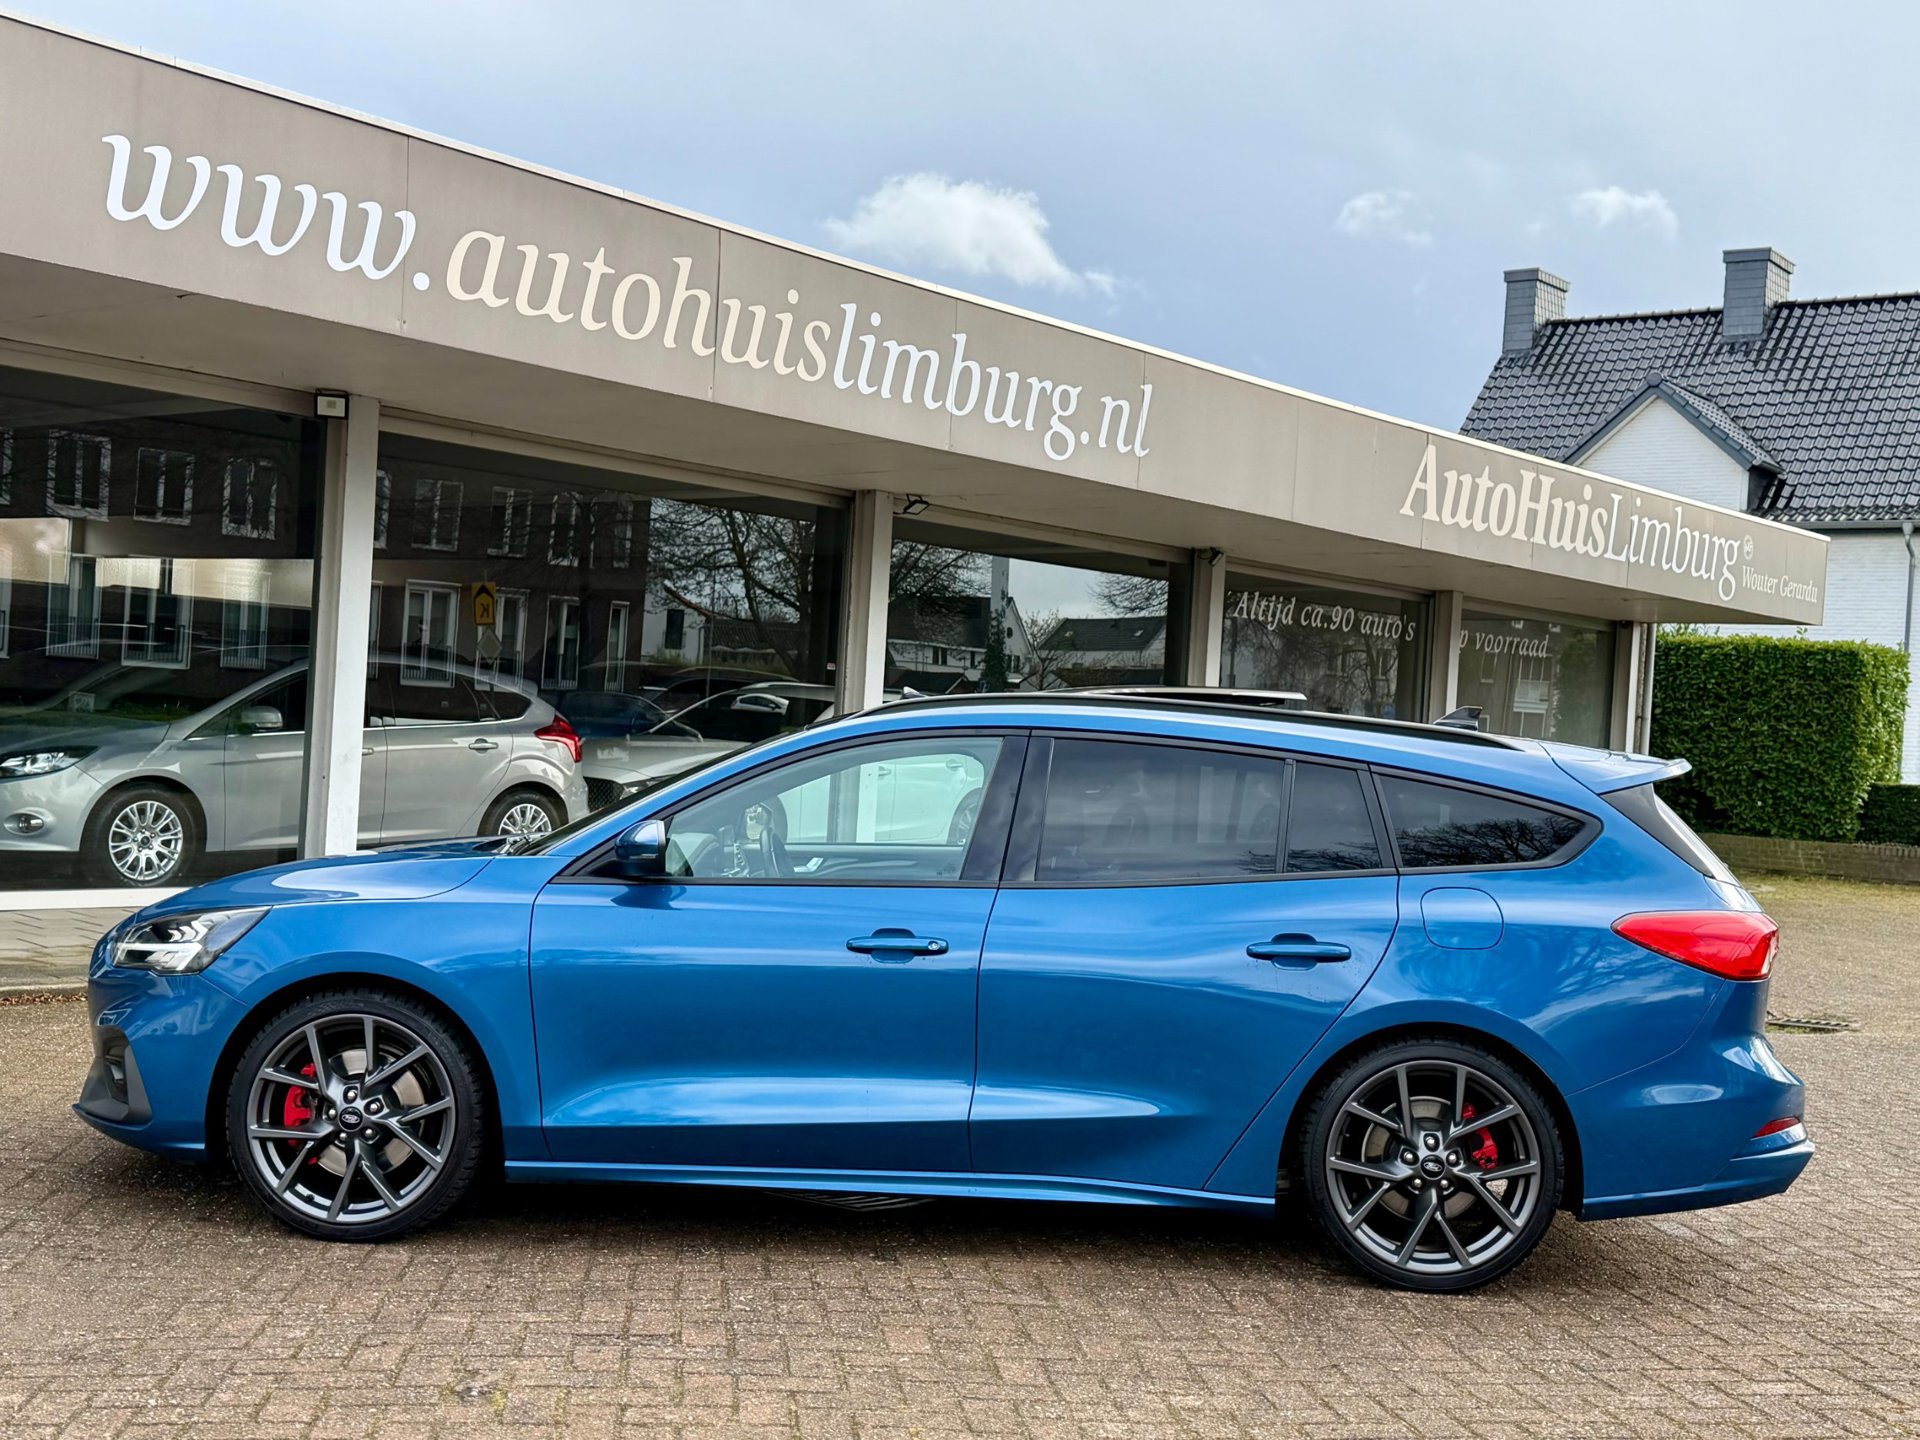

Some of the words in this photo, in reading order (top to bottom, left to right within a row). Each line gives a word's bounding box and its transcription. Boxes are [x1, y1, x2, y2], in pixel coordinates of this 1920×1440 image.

[101, 134, 1153, 461] www.autohuislimburg.nl
[1400, 444, 1742, 602] AutoHuisLimburg
[1742, 565, 1779, 595] Wouter
[1779, 575, 1819, 603] Gerardu
[1233, 591, 1297, 631] Altijd
[1360, 614, 1416, 641] auto's
[1459, 629, 1469, 654] p
[1475, 634, 1549, 658] voorraad
